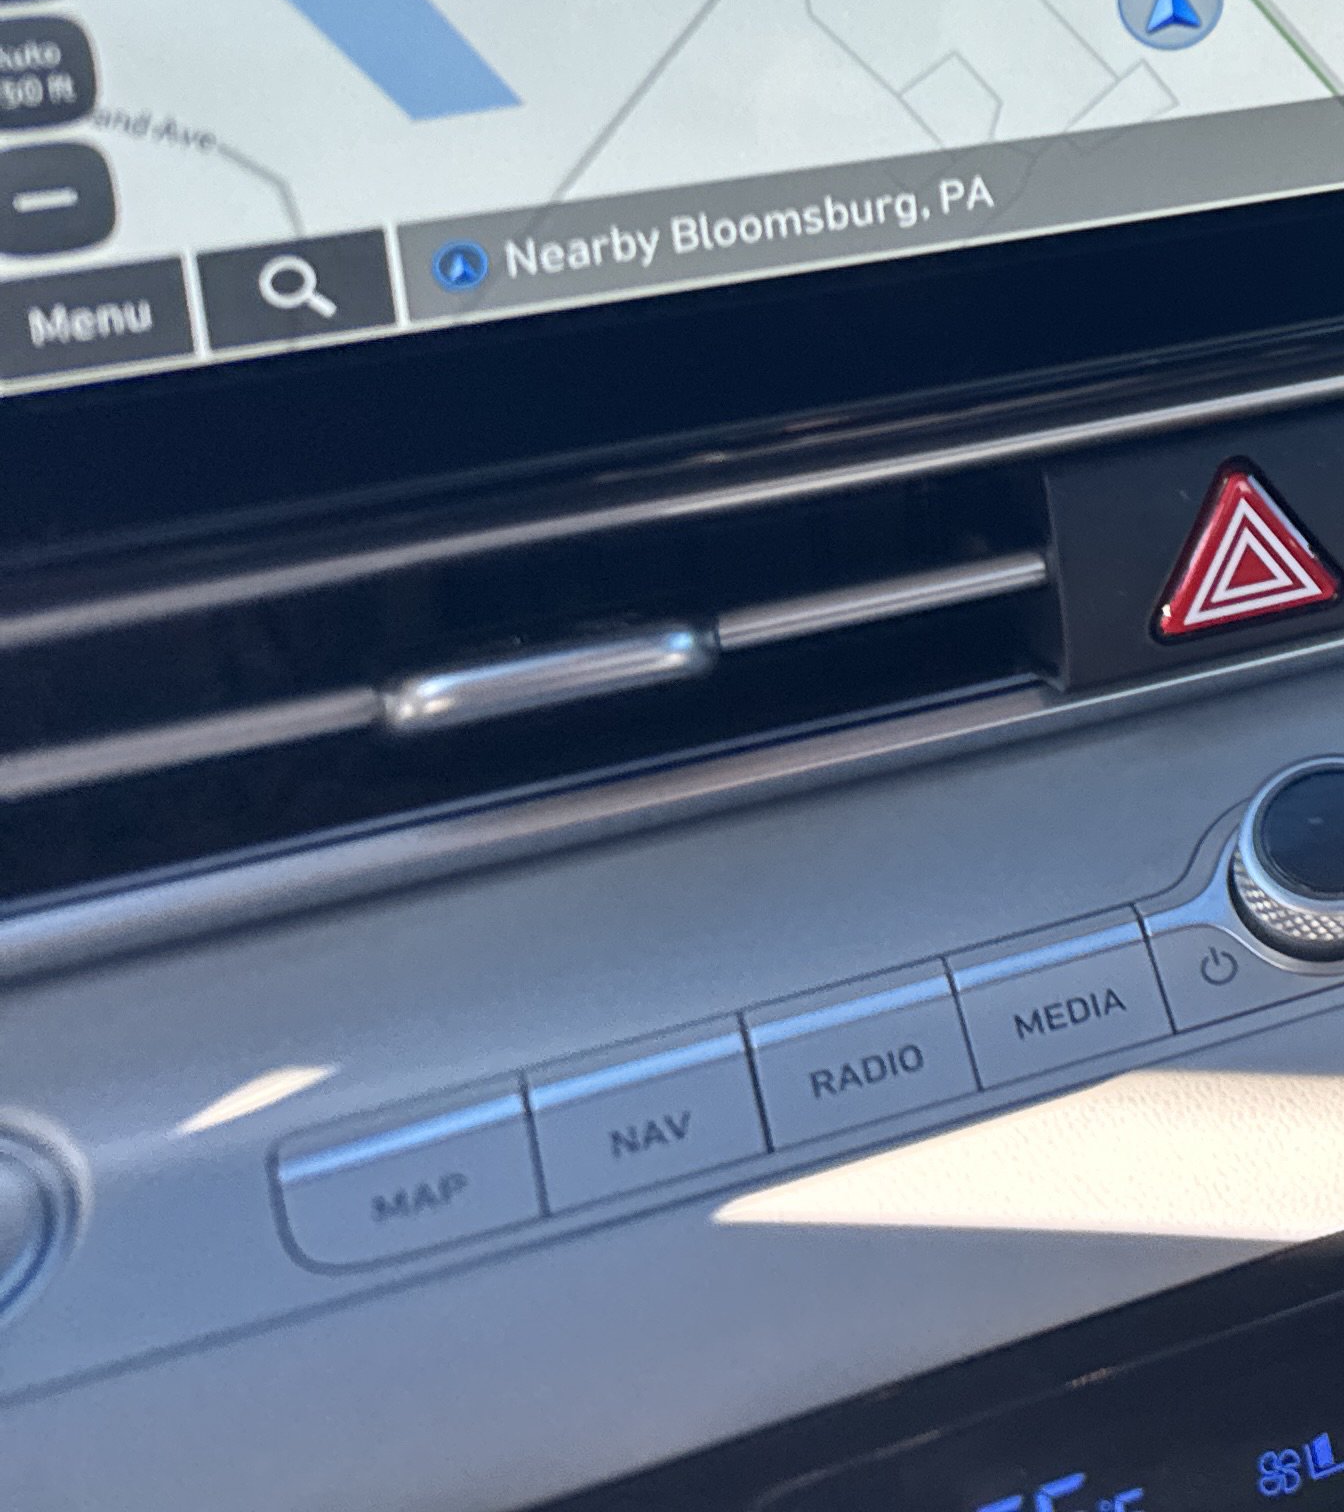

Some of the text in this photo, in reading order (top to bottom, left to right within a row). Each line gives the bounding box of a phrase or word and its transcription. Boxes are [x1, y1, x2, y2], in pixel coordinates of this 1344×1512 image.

[505, 174, 995, 278] Nearby Bloomsburg, PA
[28, 299, 152, 348] Menu
[1013, 988, 1128, 1041] MEDIA
[809, 1043, 925, 1099] RADIO
[609, 1110, 693, 1159] NAV
[371, 1172, 470, 1223] MAP
